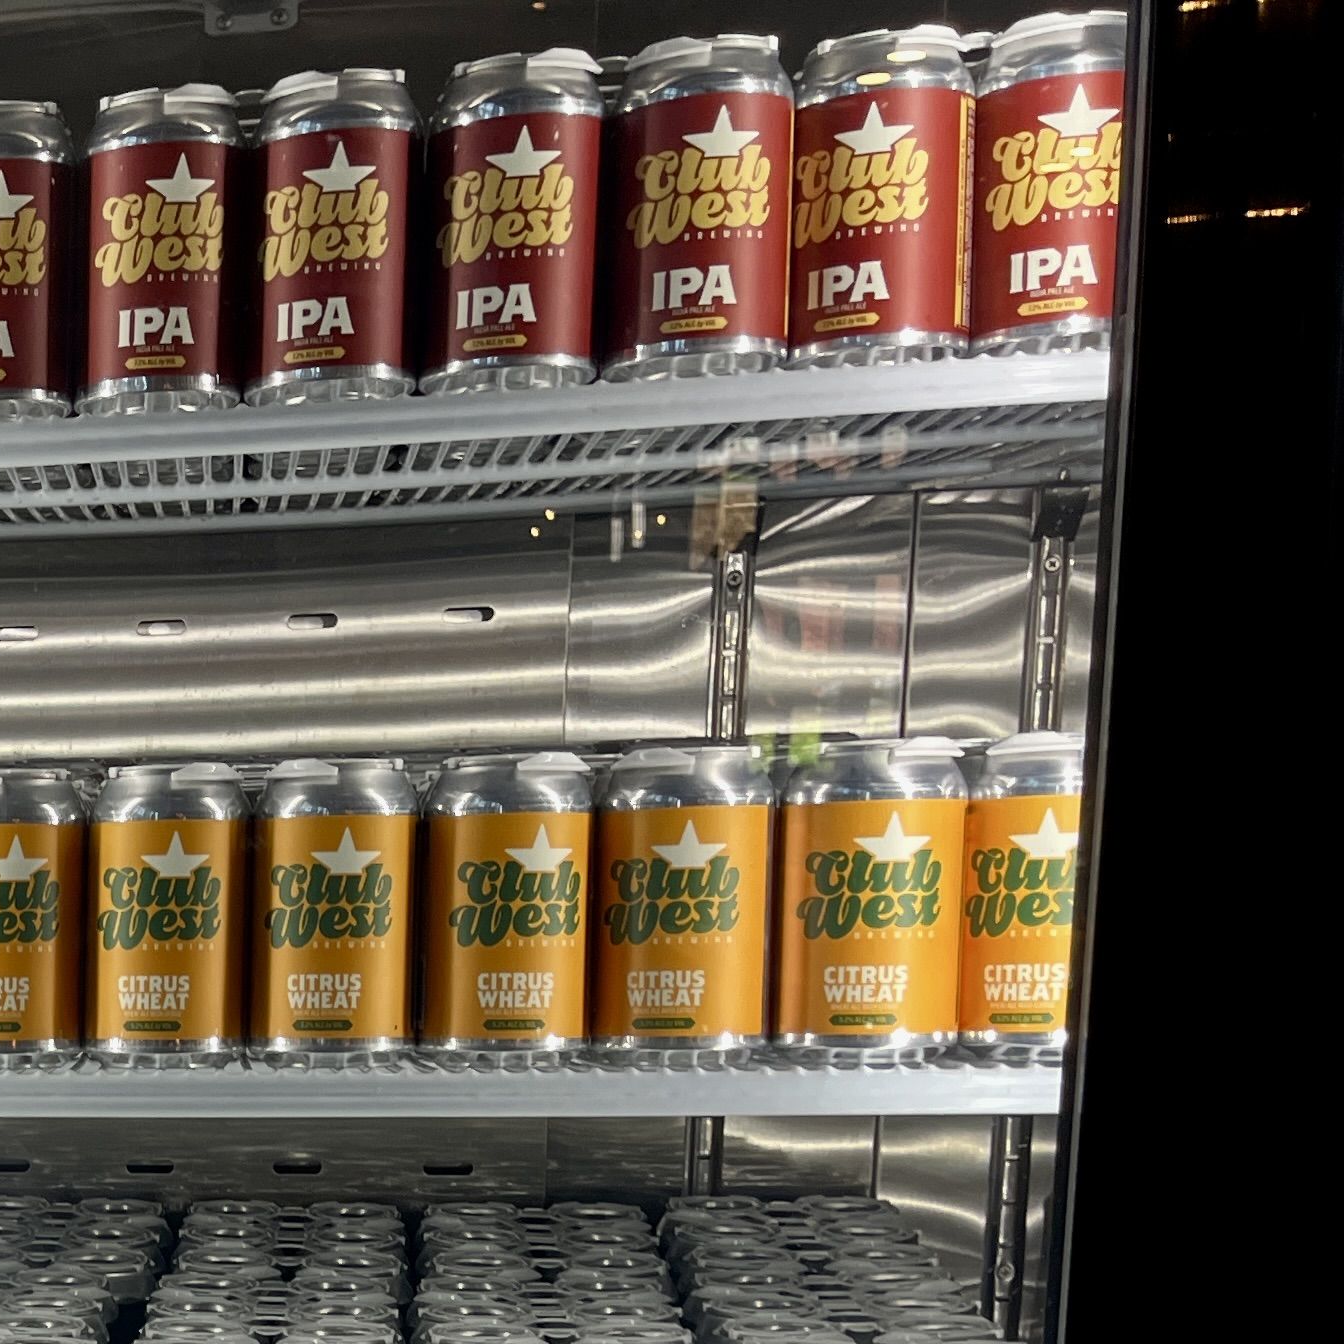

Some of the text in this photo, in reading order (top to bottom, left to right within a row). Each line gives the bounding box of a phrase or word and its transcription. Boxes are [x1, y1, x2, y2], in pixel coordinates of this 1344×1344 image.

[634, 145, 771, 199] Club
[795, 139, 929, 191] Club
[265, 179, 389, 229] Club
[445, 164, 574, 216] Club
[102, 193, 224, 239] Club
[626, 186, 771, 249] West
[795, 180, 929, 248] West
[95, 234, 224, 287] West
[258, 219, 389, 282] West
[437, 210, 573, 268] West
[651, 265, 737, 312] IPA
[807, 261, 890, 310] IPA
[1010, 244, 1097, 292] IPA
[118, 307, 195, 348] IPA
[277, 298, 355, 343] IPA
[456, 283, 537, 330] IPA
[103, 864, 221, 909] Club
[271, 864, 392, 907] Club
[611, 855, 740, 900] Club
[806, 849, 942, 894] Club
[98, 906, 221, 951] West
[265, 903, 392, 949] West
[605, 896, 739, 945] West
[797, 888, 941, 940] West
[118, 975, 190, 993] CITRUS
[287, 973, 362, 991] CITRUS
[627, 970, 705, 989] CITRUS
[627, 988, 704, 1007] WHEAT
[824, 965, 909, 984] CITRUS
[824, 984, 906, 1003] WHEAT
[118, 992, 189, 1011] WHEAT
[288, 991, 361, 1009] WHEAT
